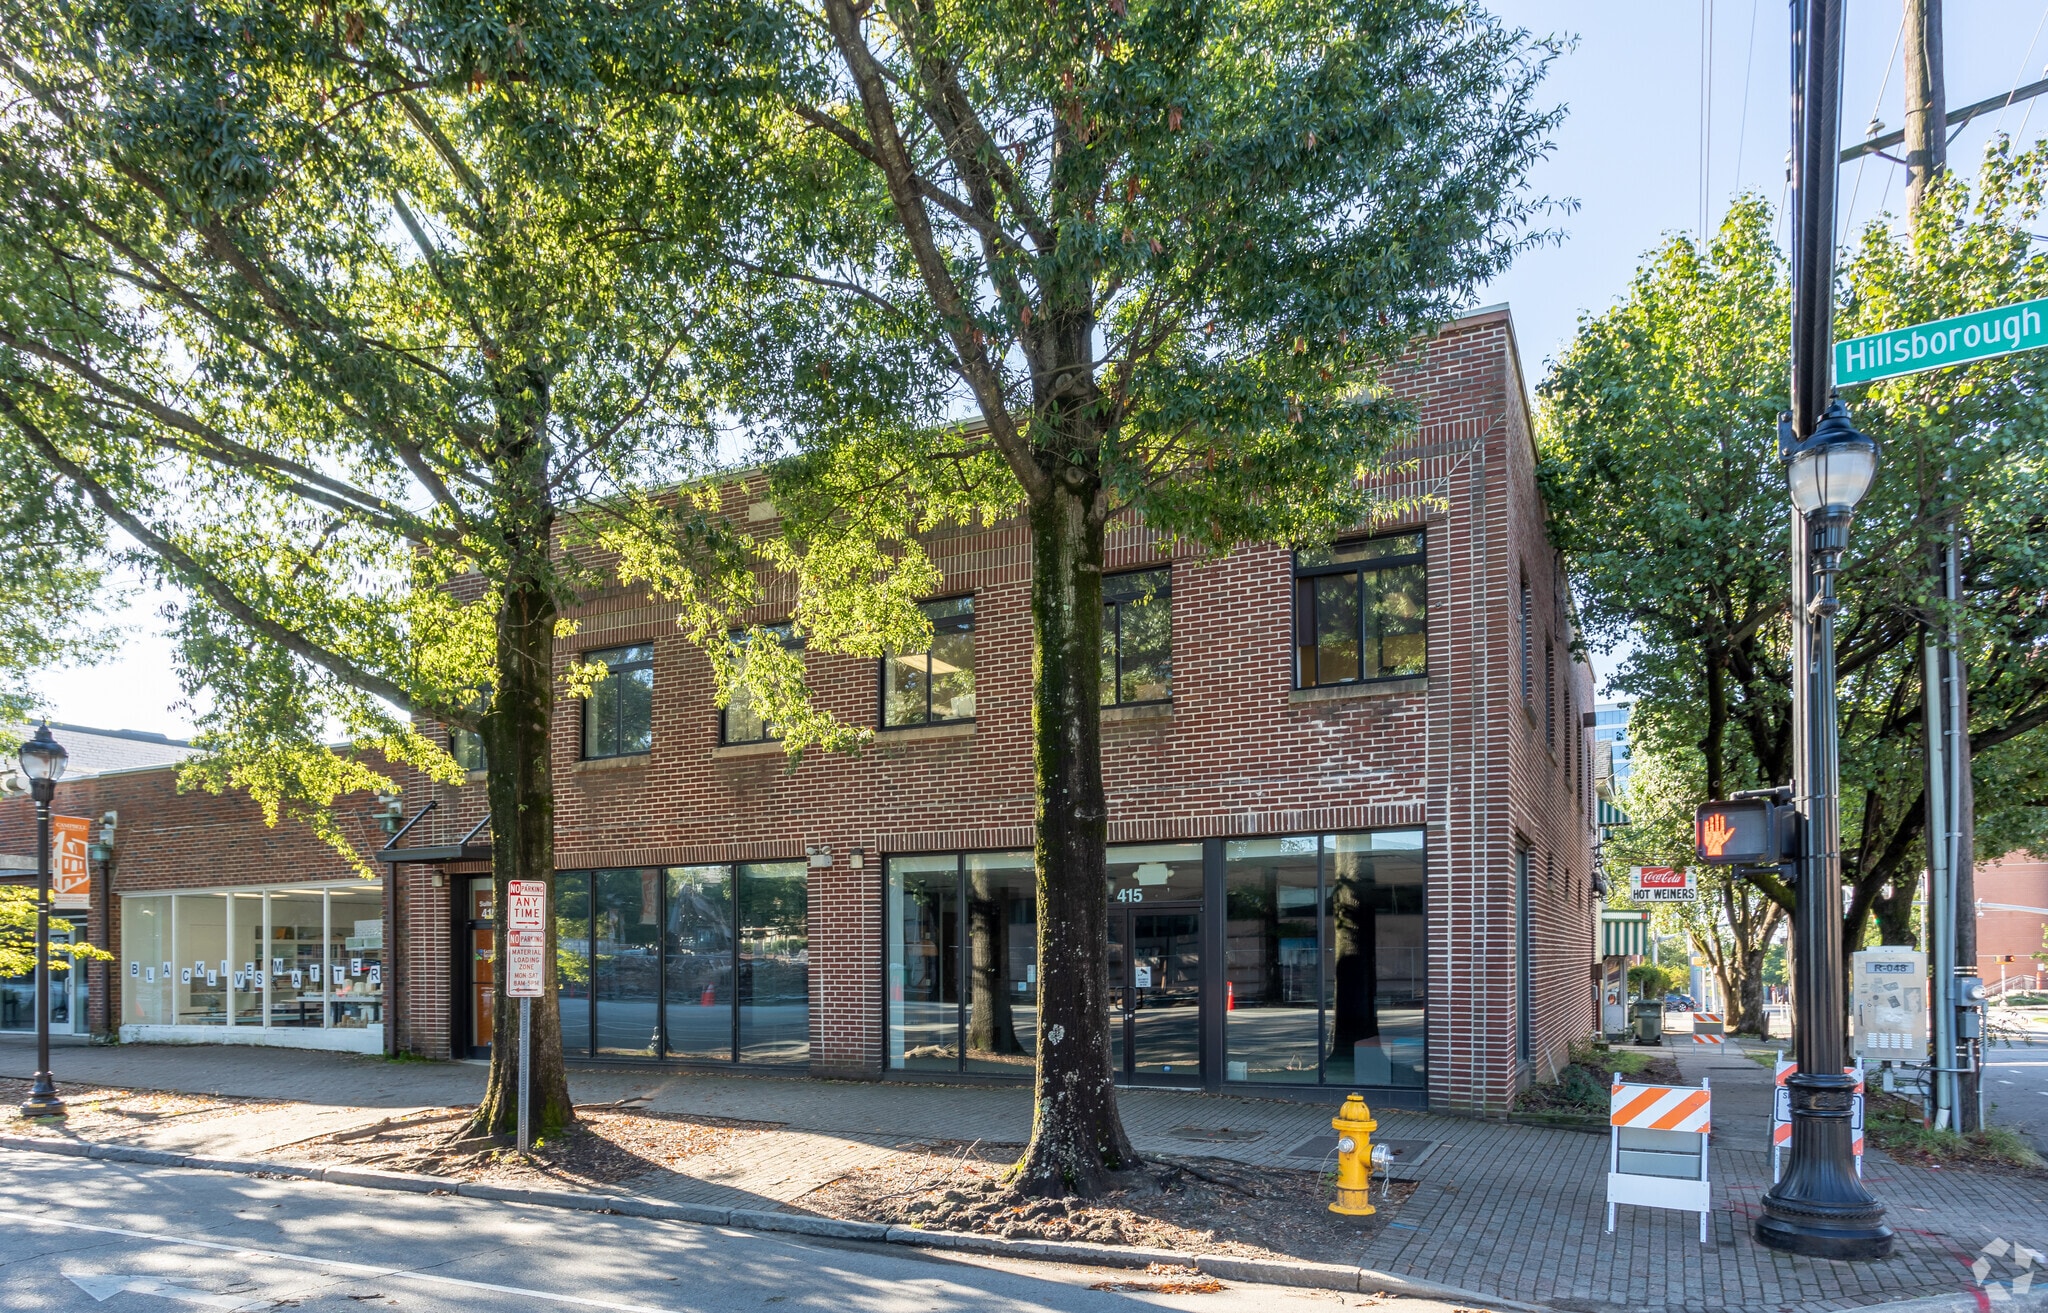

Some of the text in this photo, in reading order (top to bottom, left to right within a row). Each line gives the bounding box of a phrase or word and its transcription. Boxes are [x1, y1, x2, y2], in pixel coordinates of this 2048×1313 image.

[1846, 307, 2041, 373] Hillsborough
[510, 884, 521, 894] NO
[1633, 889, 1695, 899] HOT WEINERS
[1116, 888, 1143, 903] 415
[516, 897, 538, 907] ANY
[514, 908, 540, 918] TIME
[510, 935, 520, 944] NO
[131, 960, 380, 985] BLACK LIVES MATTER
[1874, 964, 1907, 972] R-048
